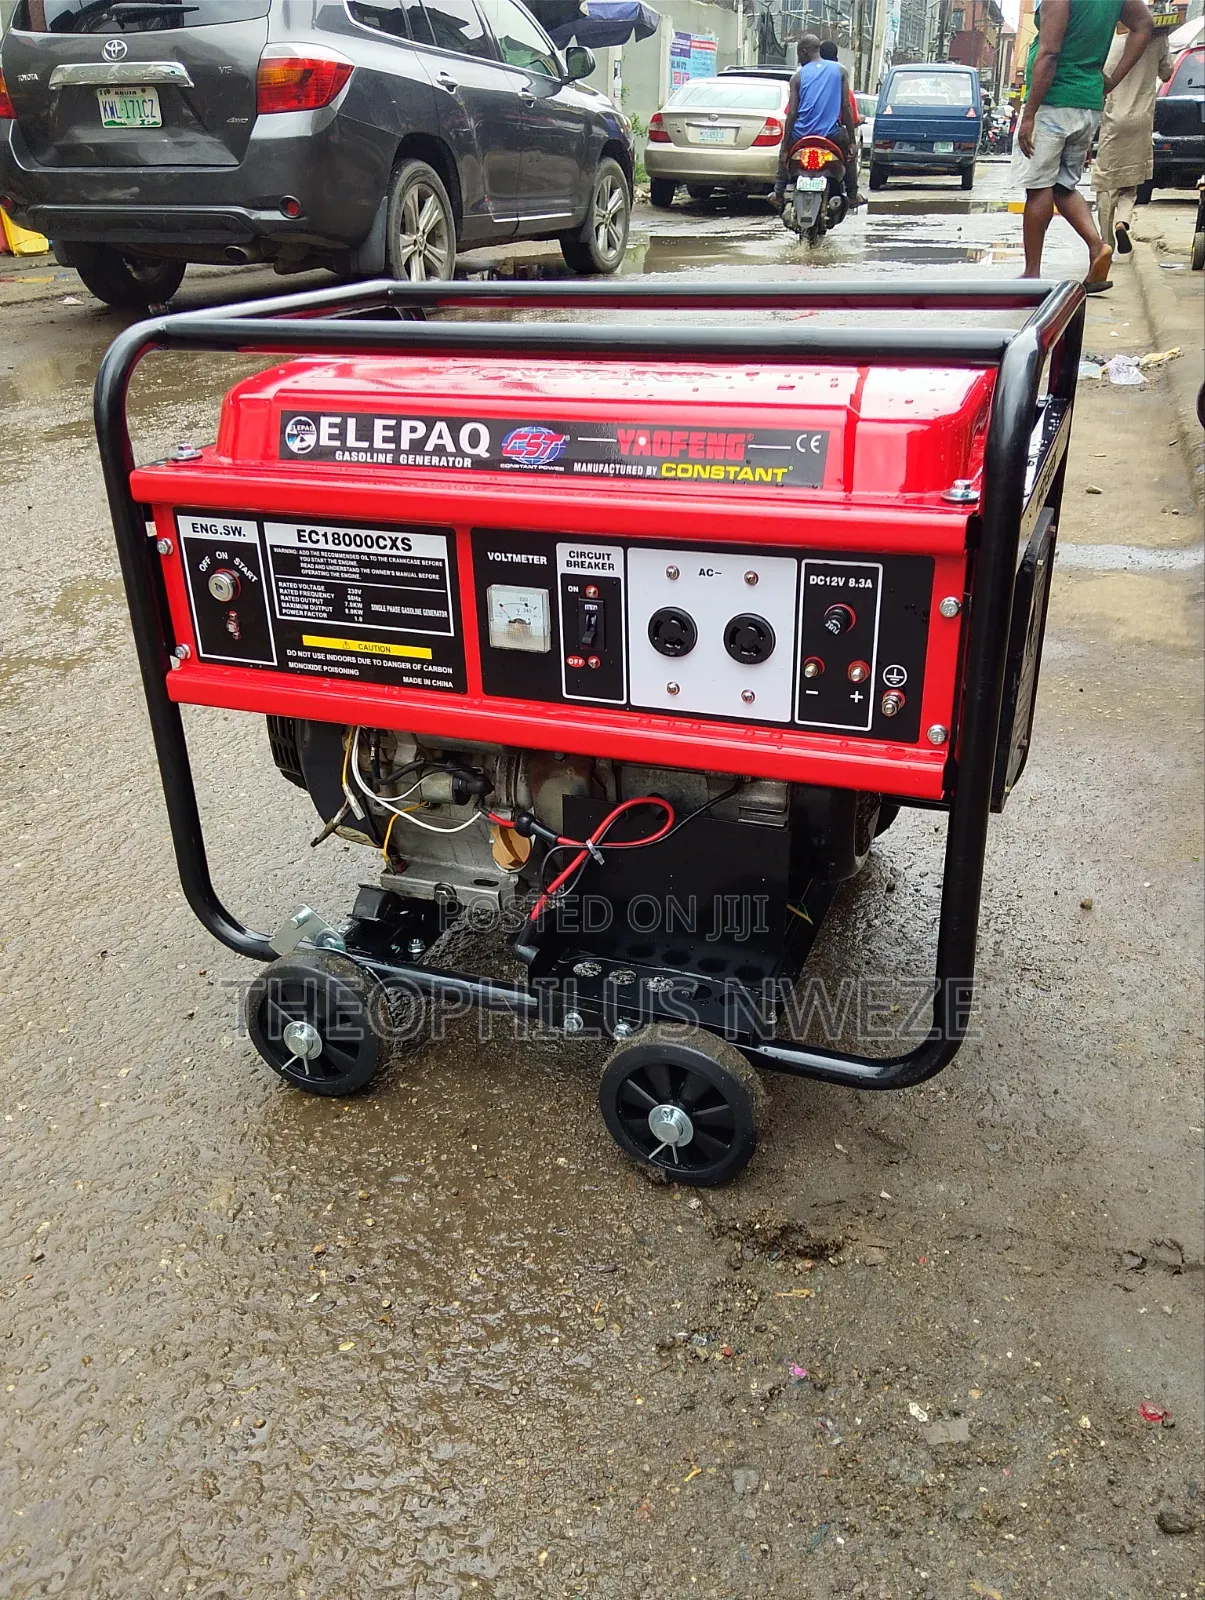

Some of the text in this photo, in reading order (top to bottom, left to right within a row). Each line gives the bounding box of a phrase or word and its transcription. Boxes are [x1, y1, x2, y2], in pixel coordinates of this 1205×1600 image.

[320, 415, 490, 458] ELEPAQ
[617, 429, 746, 461] YAOFENG
[335, 450, 472, 468] GASOLINE GENERATOR
[500, 462, 565, 472] CONSTANT POWER
[573, 461, 658, 476] MANUFACTURED BY
[661, 462, 789, 482] CONSTANT
[191, 522, 246, 538] ENG.SW.
[296, 528, 413, 553] EC18000CXS
[215, 551, 229, 560] ON
[320, 551, 360, 560] RECOMMENDED
[388, 557, 421, 566] CRANKCASE
[421, 559, 443, 567] BEFORE
[487, 551, 548, 565] VOLTMETER
[568, 550, 612, 561] CIRCUIT
[198, 555, 211, 572] OFF
[233, 557, 258, 582] START
[566, 560, 615, 571] BREAKER
[301, 569, 330, 577] OPERATING
[326, 564, 360, 573] UNDERSTAND
[395, 570, 418, 578] MANUAL
[418, 572, 440, 580] BEFORE
[278, 581, 298, 589] RATED
[298, 583, 326, 592] VOLTAGE
[809, 575, 873, 588] DC12V 8.3A
[279, 588, 299, 596] RATED
[299, 589, 335, 599] FREQUENCY
[567, 585, 579, 593] ON
[280, 595, 300, 603] RATED
[300, 597, 324, 605] OUTPUT
[281, 601, 309, 610] MAXIMUM
[309, 604, 333, 613] OUTPUT
[282, 608, 303, 616] POWER
[303, 610, 328, 619] FACTOR
[357, 643, 391, 654] CAUTION
[288, 661, 359, 675] MONOXIDE POISONING
[297, 650, 311, 658] NOT
[312, 651, 326, 660] USE
[326, 653, 356, 663] INDOORS
[357, 656, 371, 665] DUE
[372, 658, 382, 666] TO
[382, 659, 412, 670] DANGER
[423, 664, 453, 674] CARBON
[568, 657, 584, 666] OFF
[402, 676, 454, 688] MADE IN CHINA
